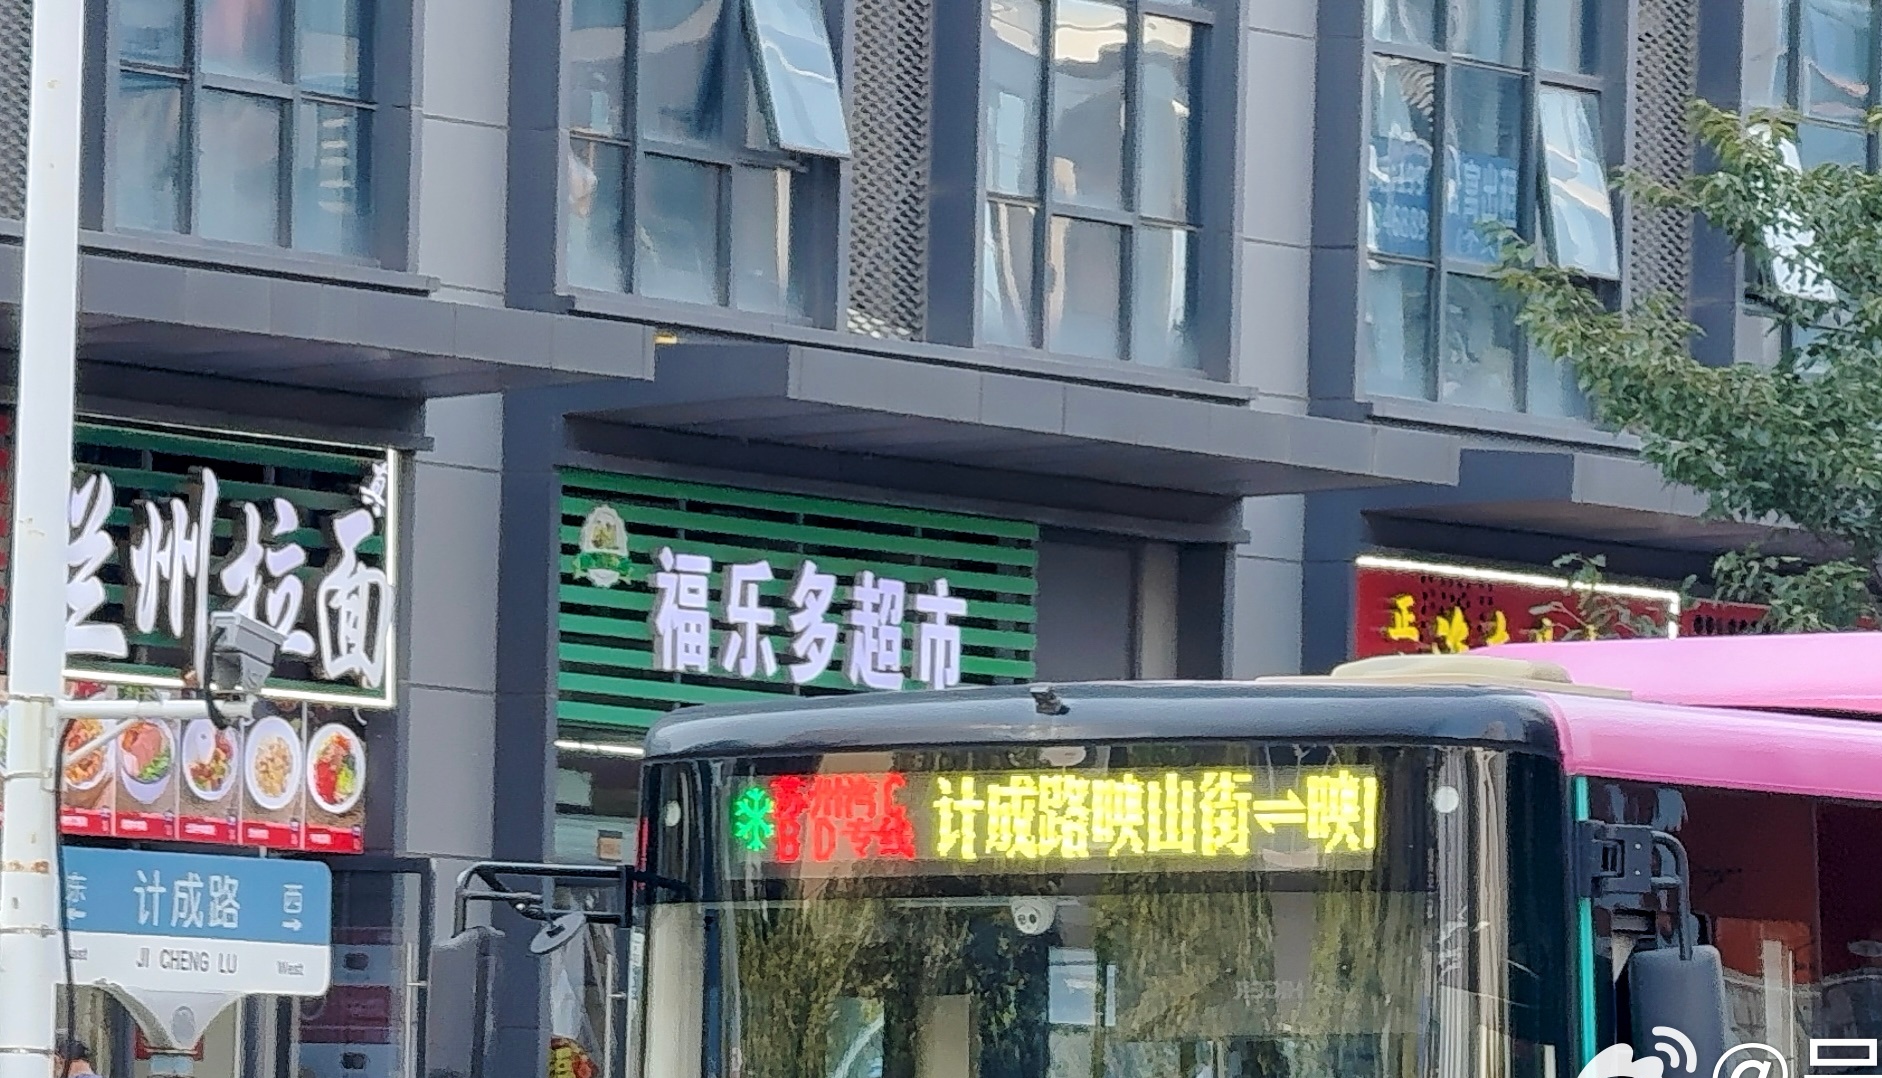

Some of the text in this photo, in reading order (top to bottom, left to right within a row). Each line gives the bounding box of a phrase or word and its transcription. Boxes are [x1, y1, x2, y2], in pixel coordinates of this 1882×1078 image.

[653, 546, 968, 690] 福乐多超市
[933, 770, 1378, 861] 计成路映山街 映
[133, 869, 241, 929] 计成路
[282, 883, 304, 914] 西
[136, 947, 238, 975] JI CHENG LU
[277, 960, 305, 976] West
